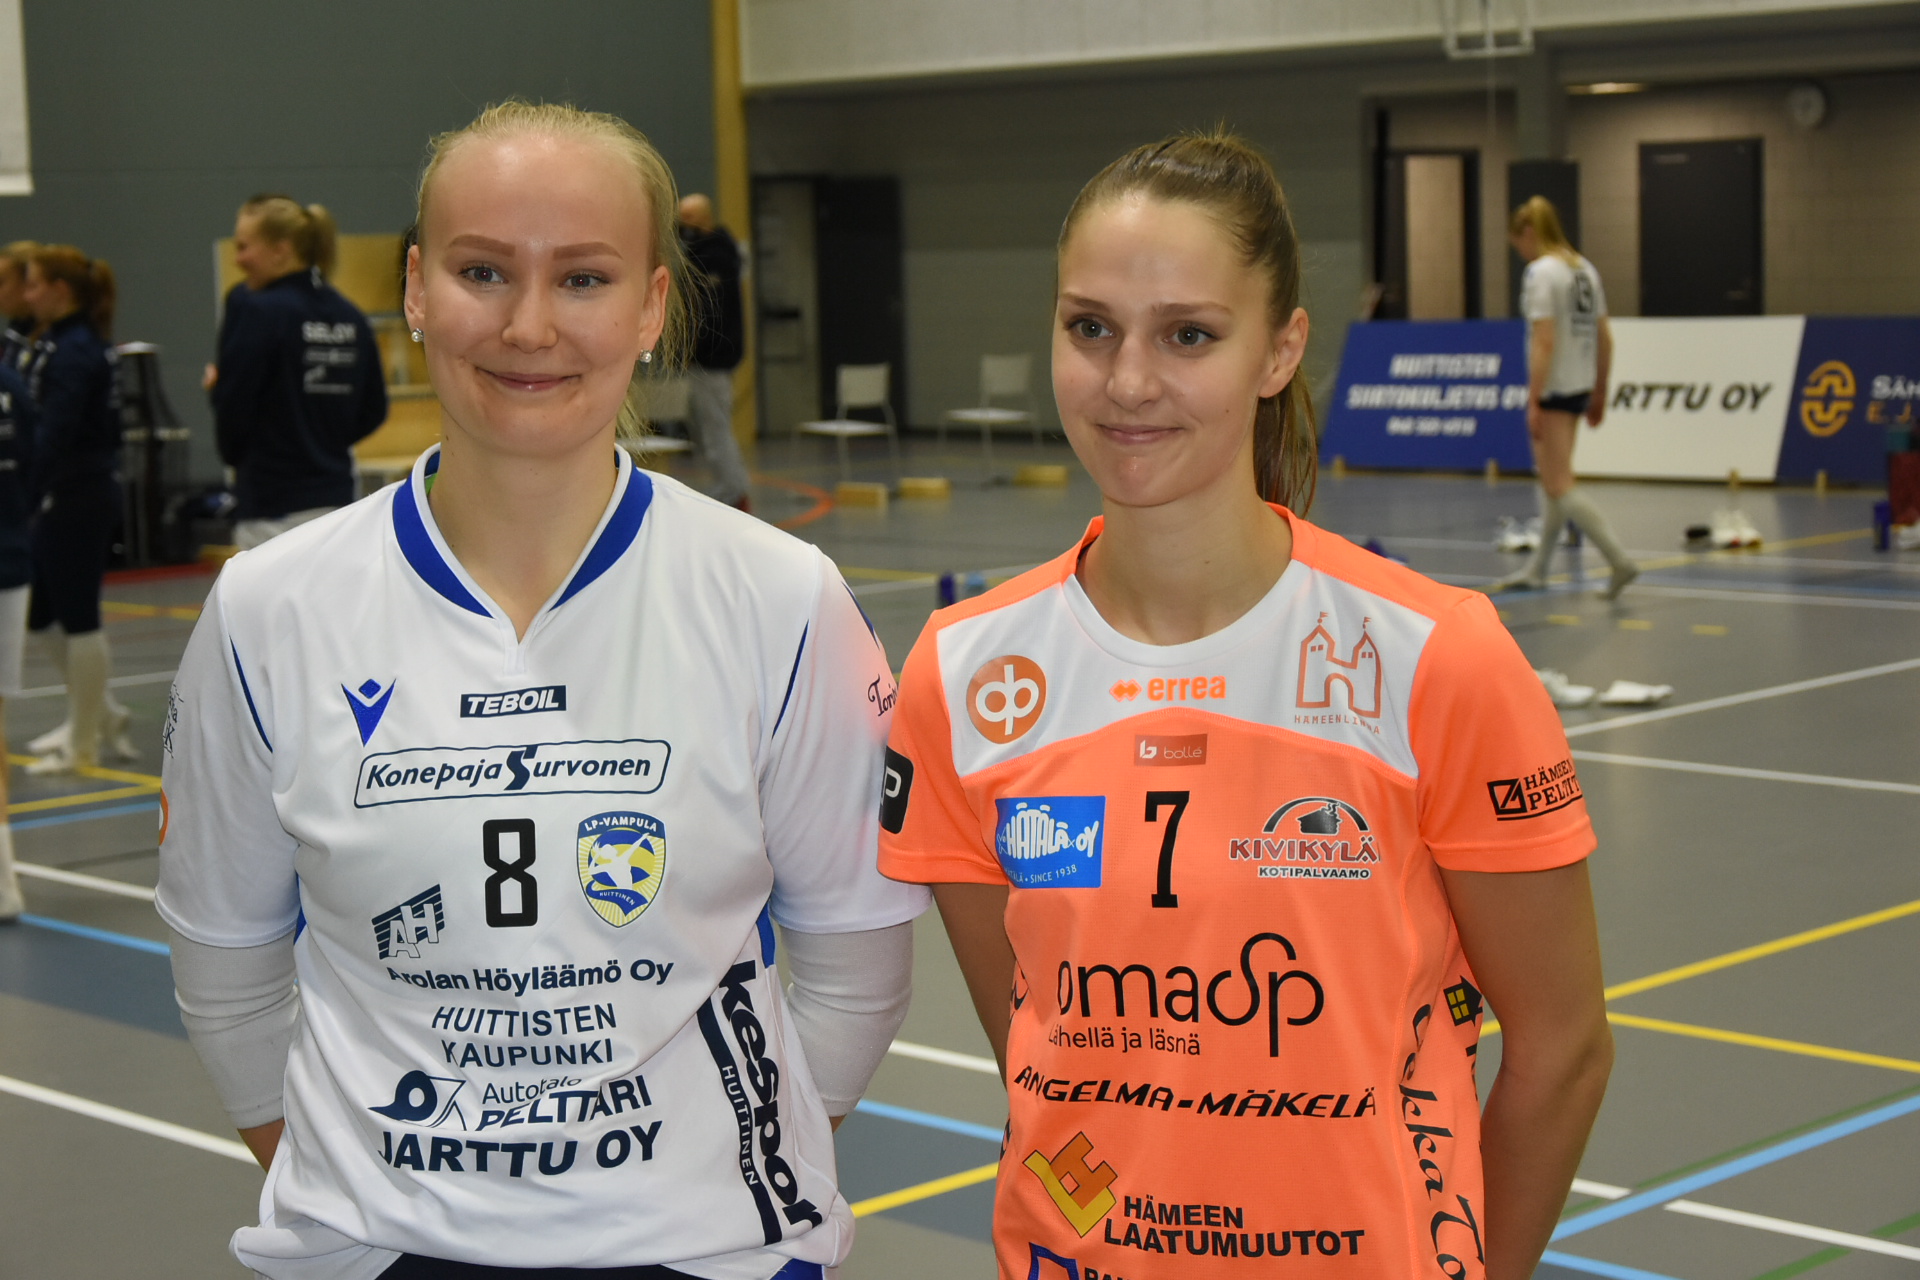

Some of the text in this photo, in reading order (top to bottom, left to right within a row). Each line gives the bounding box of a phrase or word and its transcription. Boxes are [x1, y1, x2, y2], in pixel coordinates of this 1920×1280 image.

[1609, 383, 1772, 411] RTTU OY
[467, 689, 559, 715] TEBOIL
[1147, 675, 1226, 702] errea
[366, 745, 651, 790] Konepaja Survonen
[584, 816, 657, 832] LP-VAMPULA
[1144, 790, 1190, 908] 7
[1229, 836, 1379, 863] KIVIKYLÄ
[482, 818, 538, 928] 8
[1030, 871, 1052, 884] SINCE
[1055, 863, 1077, 880] 1938
[1258, 866, 1371, 879] KOTIPALVAAMO
[386, 958, 674, 997] Arolan Höyläämö Oy
[431, 1003, 617, 1037] HUITTISTEN
[441, 1038, 613, 1068] KAUPUNKI
[1048, 1022, 1200, 1056] Lähellä ja läsnä
[475, 1074, 652, 1131] PELTTARI
[482, 1076, 582, 1105] Autotalo
[722, 1065, 758, 1186] HUITTINEN
[378, 1120, 663, 1177] JARTTU OY
[1124, 1194, 1243, 1229] HÄMEEN
[1104, 1218, 1364, 1258] LAATUMUUTOT
